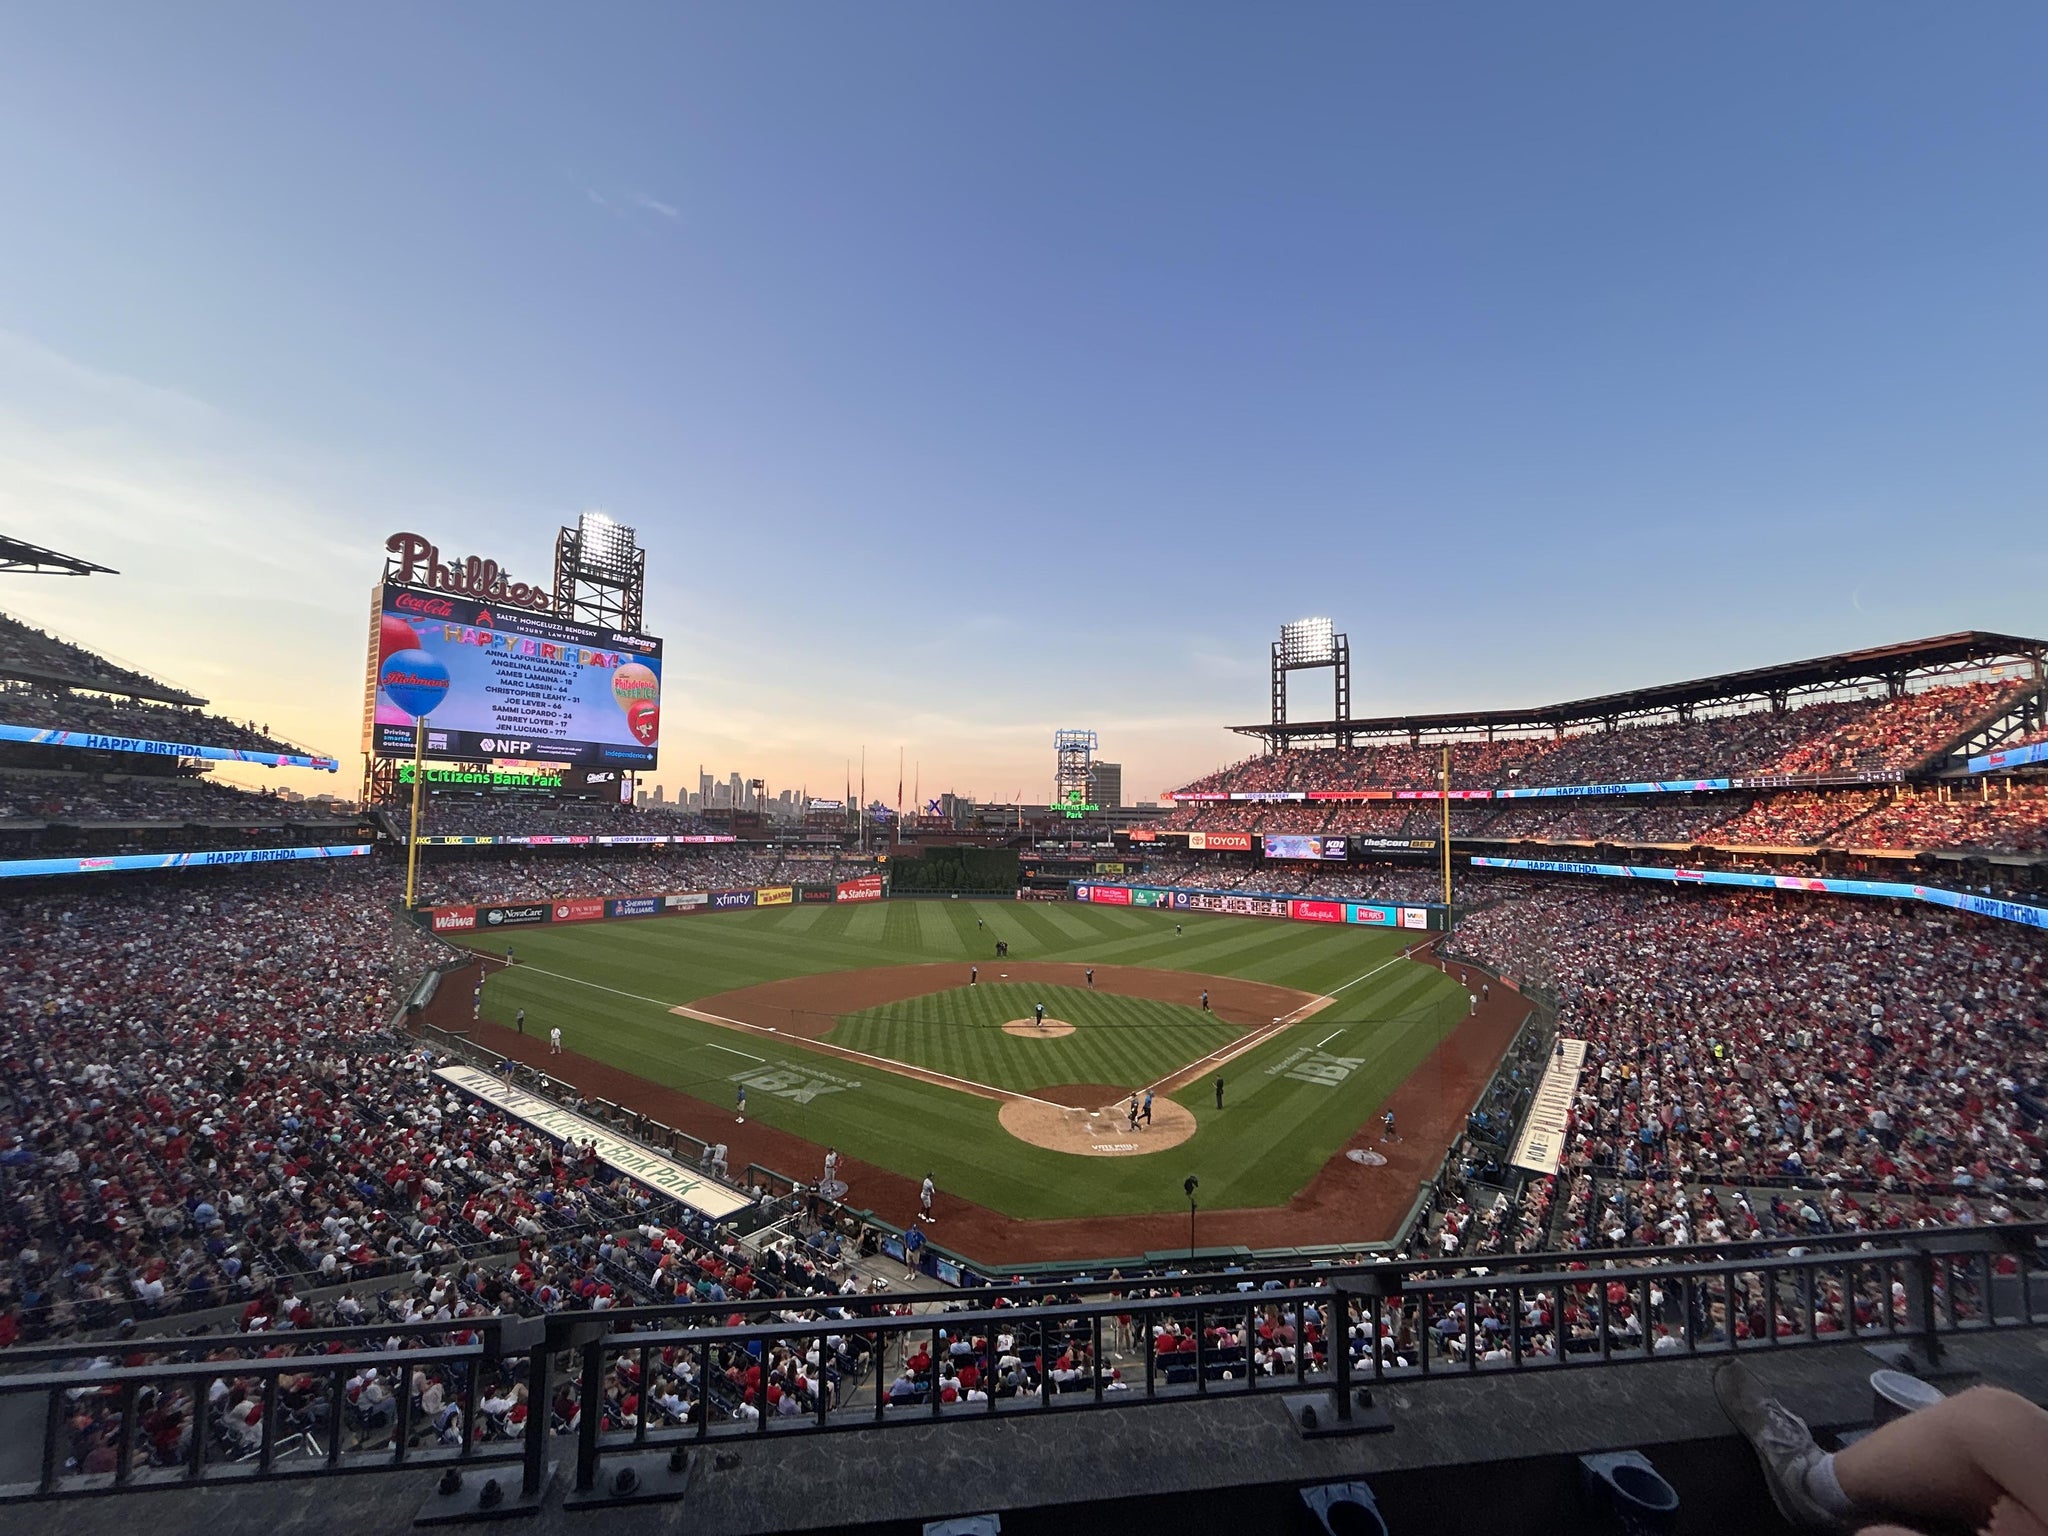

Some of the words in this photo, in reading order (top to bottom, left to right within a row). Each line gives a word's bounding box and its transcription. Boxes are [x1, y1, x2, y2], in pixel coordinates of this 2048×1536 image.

[385, 532, 549, 611] Phillies
[395, 593, 454, 616] Coca-Cola
[496, 613, 517, 623] SALTZ
[520, 617, 563, 631] MONGELUZZI
[565, 626, 597, 637] BENDESKY
[517, 626, 543, 635] INJURY
[548, 632, 579, 641] LAWYERS
[444, 624, 519, 652] HAPPY
[522, 638, 619, 669] BIRTHDAY!
[612, 634, 657, 649] theScore
[485, 650, 508, 659] ANNA
[550, 660, 569, 668] KANE
[491, 659, 532, 671] ANGELINA
[533, 665, 567, 676] LAMAINA
[496, 669, 523, 679] JAMES
[524, 673, 558, 684] LAMAINA
[500, 679, 523, 687] MARC
[526, 681, 552, 691] LASSIN
[485, 686, 541, 698] CHRISTOPHER
[542, 692, 567, 702] LEAHY
[504, 697, 520, 706] JOE
[522, 699, 546, 708] LEVER
[492, 705, 519, 714] SAMMI
[521, 708, 557, 718] LOPARDO
[496, 714, 528, 724] AUBREY
[529, 717, 554, 726] LOYER
[383, 729, 410, 737] Driving
[496, 724, 512, 732] JEN
[513, 725, 549, 735] LUCIANO
[86, 735, 140, 751] HAPPY
[145, 741, 203, 757] BIRTHDA
[497, 740, 531, 755] NFP
[605, 750, 646, 759] Independence
[427, 769, 490, 784] Citizens
[493, 772, 529, 785] Bank
[532, 775, 562, 787] Park
[1556, 786, 1584, 796] HAPPY
[1587, 784, 1627, 795] BIRTHDA
[1050, 803, 1079, 811] Citizens
[1066, 811, 1083, 819] Park
[1207, 837, 1247, 846] TOYOTA
[1364, 839, 1409, 848] theScore
[207, 852, 248, 864] HAPPY
[252, 850, 296, 862] BIRTHDA
[1527, 861, 1555, 871] HAPPY
[1558, 864, 1598, 874] BIRTHDA
[716, 892, 751, 907] xfinity
[847, 889, 865, 899] State
[865, 888, 881, 897] Farm
[625, 899, 654, 907] SHERWIN
[504, 908, 542, 919] NovaCare
[1974, 897, 1999, 917] HAPPY
[2002, 902, 2040, 925] BIRTHDA
[435, 917, 474, 929] Wawa
[458, 1074, 535, 1108] WELCOME
[728, 1065, 846, 1104] IBX
[606, 1144, 658, 1177] Bank
[656, 1167, 701, 1195] Park
